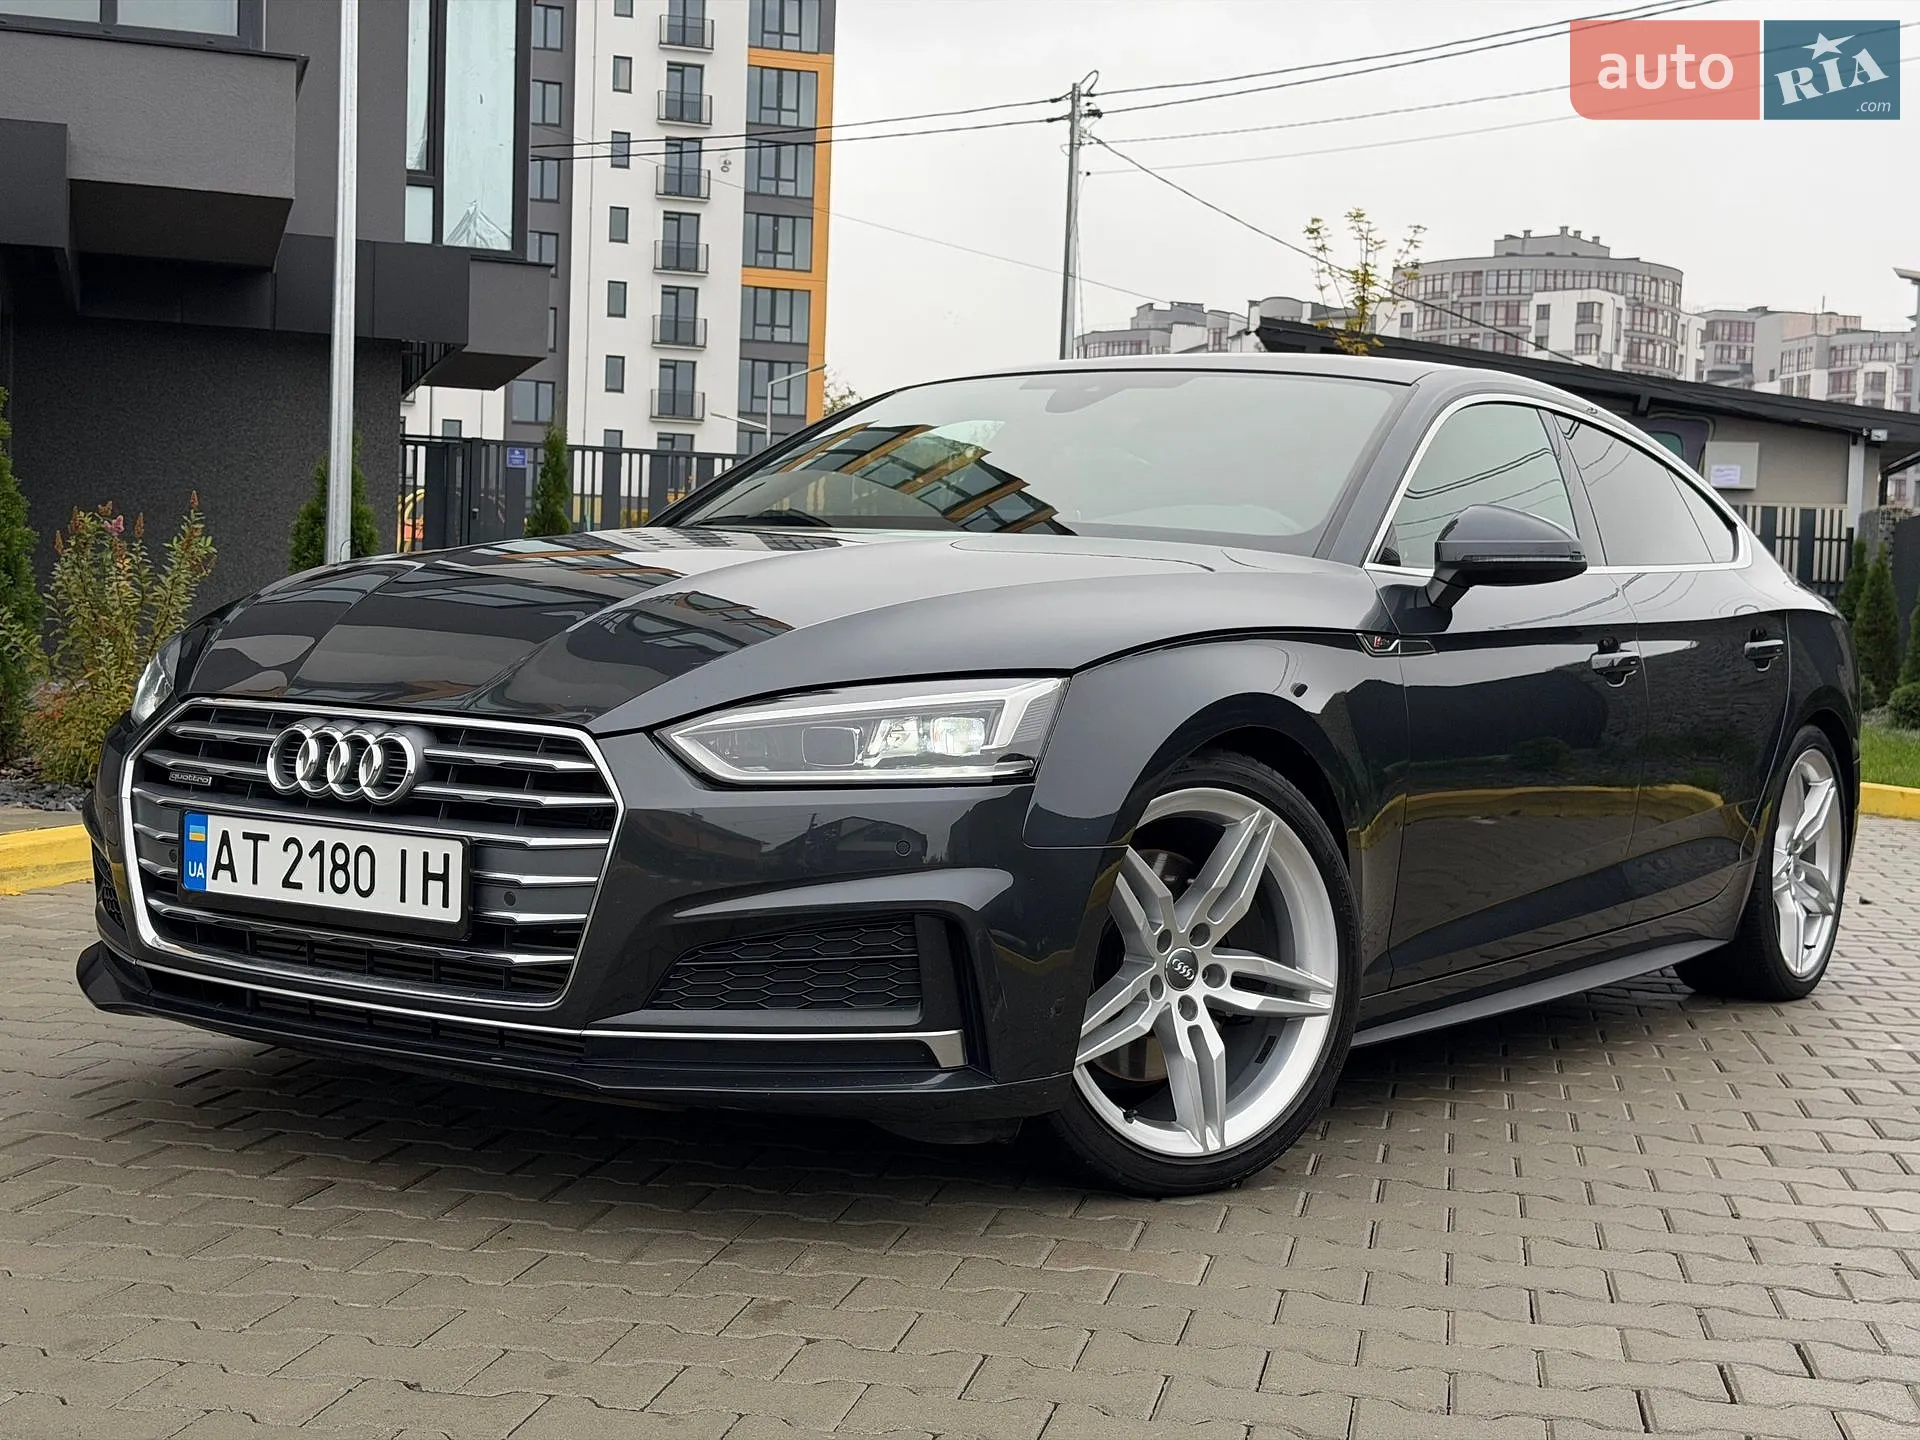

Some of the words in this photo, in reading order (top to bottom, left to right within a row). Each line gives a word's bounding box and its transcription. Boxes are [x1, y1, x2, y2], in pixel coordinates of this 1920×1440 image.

[171, 772, 209, 784] quattro
[188, 861, 205, 879] UA
[211, 829, 270, 886] AT
[281, 836, 376, 898] 2180
[399, 848, 450, 909] IH
